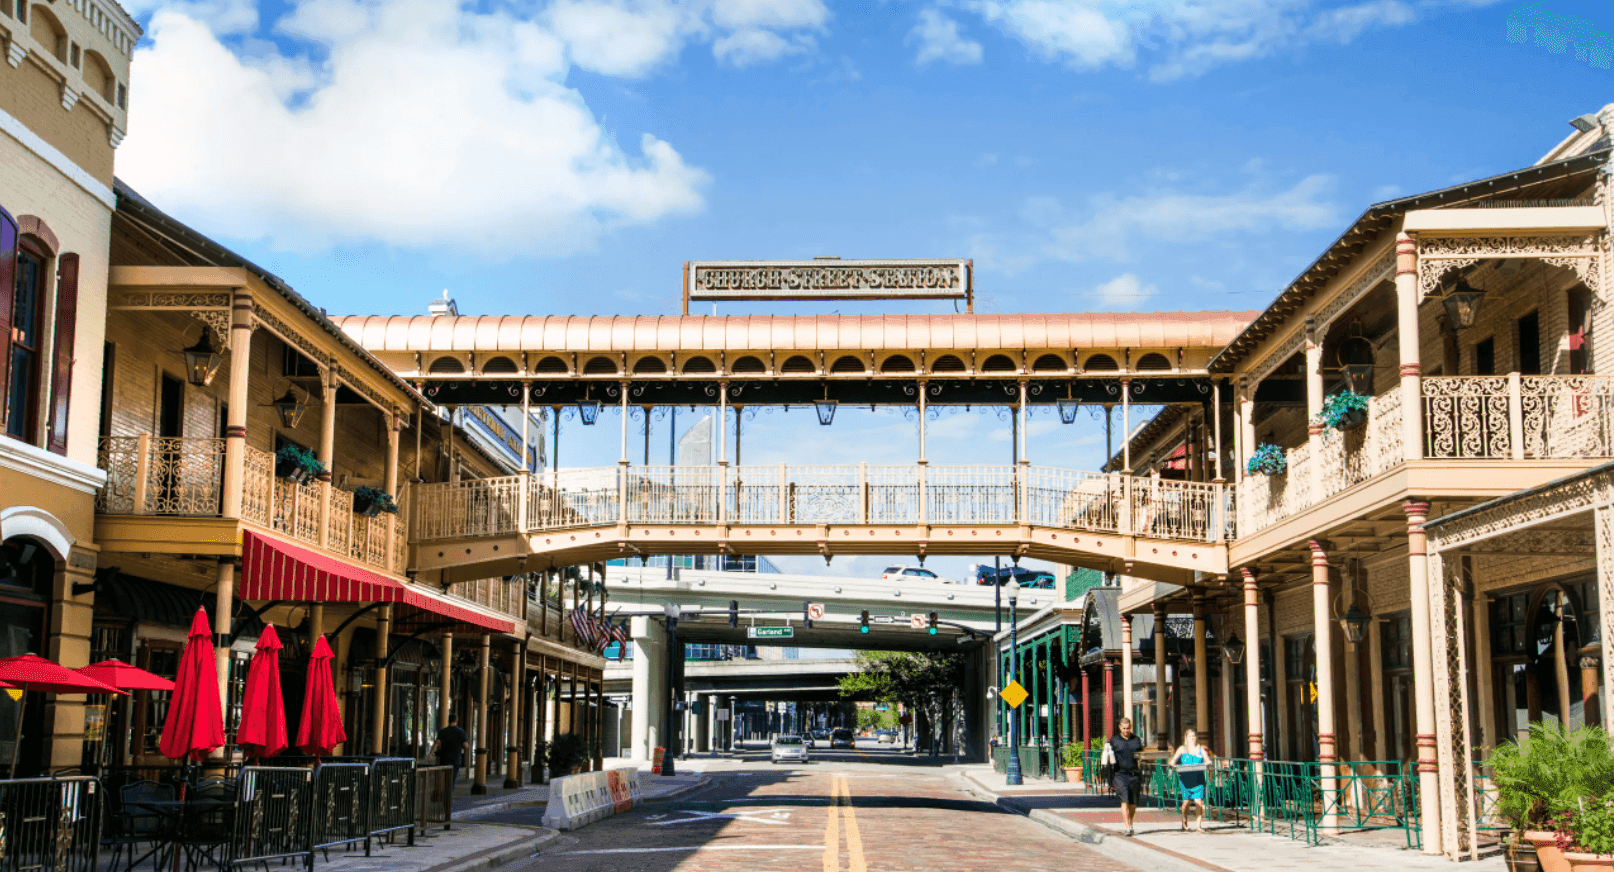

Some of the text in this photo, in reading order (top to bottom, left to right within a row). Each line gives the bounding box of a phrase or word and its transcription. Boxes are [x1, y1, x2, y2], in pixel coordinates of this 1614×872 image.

[704, 266, 955, 290] CHURCH STREET STATION
